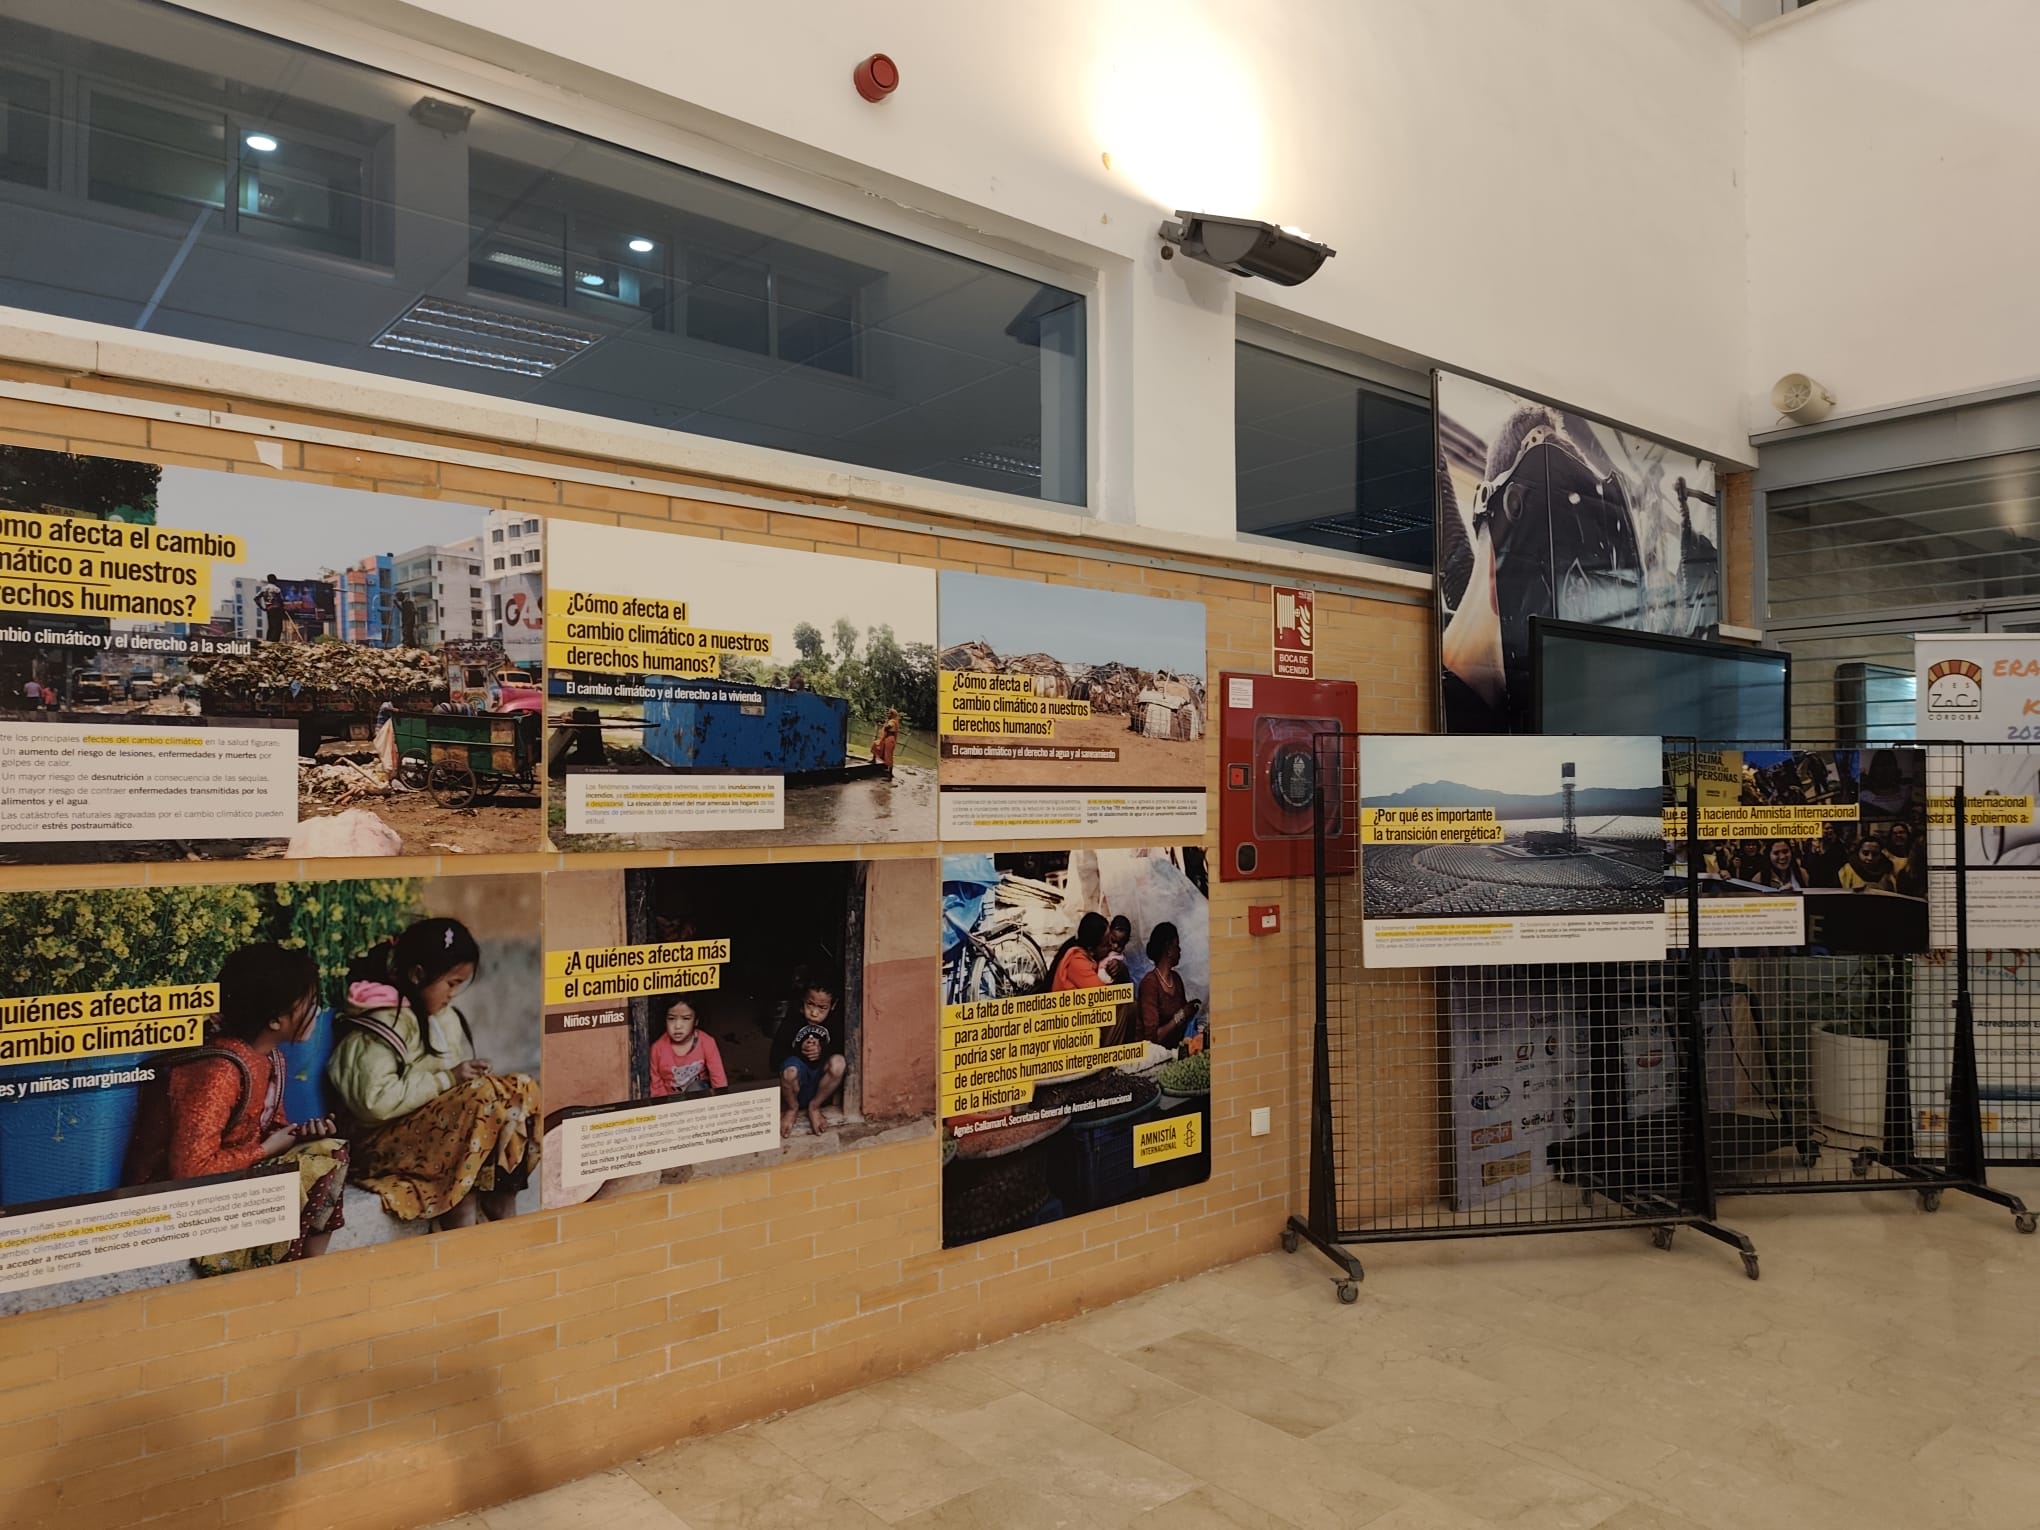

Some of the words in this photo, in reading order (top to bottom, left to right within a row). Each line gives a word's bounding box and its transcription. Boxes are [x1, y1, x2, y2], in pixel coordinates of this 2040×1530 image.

[0, 518, 42, 539] mo
[49, 519, 123, 547] afecta
[130, 527, 149, 549] el
[156, 533, 235, 557] cambio
[79, 559, 92, 576] a
[100, 561, 197, 586] nuestros
[0, 583, 74, 608] echos
[81, 586, 196, 617] humanos?
[567, 592, 617, 615] ¿Cómo
[622, 598, 669, 619] afecta
[673, 603, 686, 621] el
[34, 628, 101, 646] climático
[103, 636, 112, 649] y
[115, 634, 127, 648] el
[131, 635, 187, 651] derecho
[190, 643, 198, 652] a
[201, 639, 214, 653] la
[216, 641, 250, 655] salud
[567, 621, 624, 641] cambio
[628, 625, 694, 646] climático
[698, 633, 706, 647] a
[711, 634, 769, 652] nuestros
[567, 646, 639, 668] derechos
[643, 651, 716, 673] humanos?
[1278, 665, 1309, 675] INCENDIO
[1279, 653, 1298, 663] BOCA
[1299, 656, 1308, 664] DE
[566, 682, 576, 694] El
[577, 683, 612, 696] cambio
[614, 685, 656, 698] climático
[657, 689, 663, 700] y
[664, 686, 673, 699] el
[674, 688, 710, 701] derecho
[711, 692, 718, 701] a
[719, 689, 727, 701] la
[728, 690, 761, 703] vivienda
[952, 673, 986, 691] ¿Cómo
[989, 675, 1021, 692] afecta
[1023, 677, 1032, 692] el
[952, 696, 990, 711] cambio
[993, 697, 1037, 713] climático
[1040, 703, 1046, 713] a
[1049, 702, 1088, 716] nuestros
[953, 716, 1001, 733] derechos
[1003, 718, 1052, 735] humanos?
[61, 748, 75, 756] del
[77, 749, 104, 758] riesgo
[106, 749, 117, 757] de
[119, 749, 155, 758] lesiones,
[158, 750, 216, 759] enfermedades
[218, 752, 222, 760] y
[259, 753, 272, 761] por
[952, 745, 958, 754] El
[959, 746, 983, 755] cambio
[984, 745, 1011, 756] climático
[1012, 749, 1017, 758] y
[1018, 747, 1023, 756] el
[1024, 747, 1048, 757] derecho
[1049, 748, 1055, 757] al
[1055, 750, 1070, 759] agua
[1070, 750, 1074, 759] y
[1074, 748, 1080, 757] al
[1373, 808, 1397, 825] ¿Por
[1399, 808, 1418, 824] qué
[1421, 811, 1433, 822] es
[1436, 808, 1492, 824] importante
[1704, 807, 1748, 821] haciendo
[1750, 807, 1791, 820] Amnistía
[1794, 804, 1857, 818] Internacional
[1970, 812, 2018, 825] gobiernos
[1, 822, 39, 832] producir
[41, 822, 68, 830] estrés
[71, 821, 134, 831] postraumático.
[1374, 827, 1383, 840] la
[1386, 827, 1437, 841] transición
[1440, 826, 1501, 842] energética?
[1721, 824, 1730, 837] el
[1732, 823, 1768, 837] cambio
[1771, 822, 1820, 836] climático?
[564, 951, 581, 976] ¿A
[586, 948, 644, 973] quiénes
[648, 945, 693, 964] afecta
[697, 941, 727, 960] más
[565, 979, 578, 998] el
[583, 974, 638, 996] cambio
[643, 966, 716, 991] climático?
[0, 998, 83, 1029] uiénes
[90, 992, 161, 1018] afecta
[169, 986, 214, 1009] más
[955, 1004, 974, 1021] «La
[976, 1003, 999, 1019] falta
[1002, 1002, 1014, 1015] de
[1016, 996, 1057, 1013] medidas
[1059, 993, 1070, 1007] de
[1073, 992, 1086, 1006] los
[1088, 987, 1132, 1007] gobiernos
[563, 1014, 590, 1028] Niños
[591, 1015, 597, 1027] y
[599, 1011, 624, 1025] niñas
[955, 1031, 978, 1047] para
[981, 1021, 1020, 1039] abordar
[1023, 1018, 1032, 1034] el
[1034, 1014, 1069, 1031] cambio
[1071, 1008, 1113, 1026] climático
[83, 1018, 198, 1051] climático?
[955, 1046, 987, 1069] podría
[990, 1048, 1006, 1061] ser
[1008, 1043, 1017, 1058] la
[1020, 1040, 1050, 1057] mayor
[1052, 1033, 1093, 1052] violación
[955, 1073, 967, 1089] de
[970, 1065, 1017, 1086] derechos
[1020, 1059, 1064, 1078] humanos
[1065, 1043, 1144, 1070] intergeneracional
[17, 1082, 28, 1098] y
[30, 1076, 70, 1094] niñas
[72, 1067, 156, 1089] marginadas
[955, 1095, 967, 1112] de
[970, 1092, 979, 1108] la
[982, 1085, 1027, 1106] Historia»
[953, 1125, 974, 1137] Agnès
[1008, 1109, 1040, 1125] Secretaria
[1040, 1103, 1063, 1120] General
[1063, 1102, 1071, 1115] de
[1072, 1099, 1096, 1114] Amnistía
[1096, 1092, 1132, 1108] Internacional
[1140, 1125, 1177, 1147] AMNISTÍA
[1140, 1141, 1177, 1157] INTERNACIONAL
